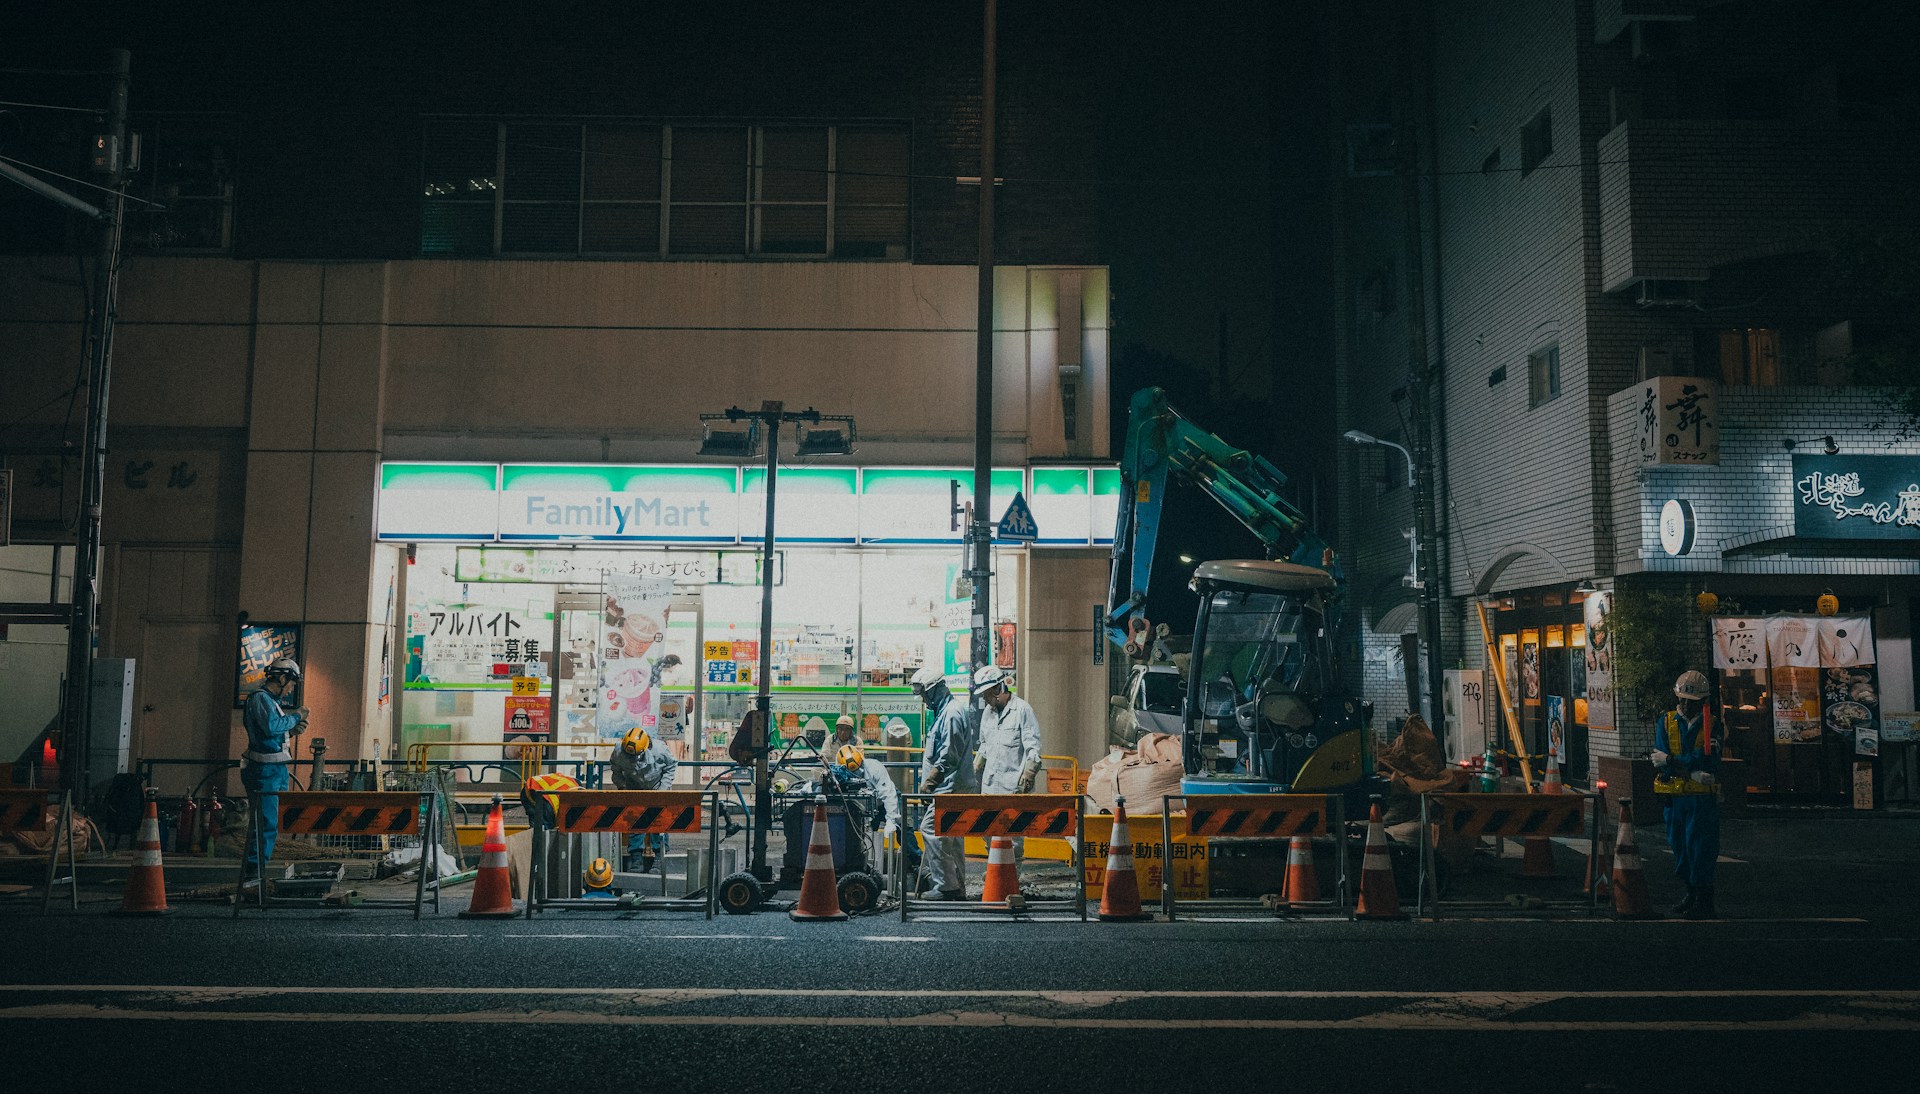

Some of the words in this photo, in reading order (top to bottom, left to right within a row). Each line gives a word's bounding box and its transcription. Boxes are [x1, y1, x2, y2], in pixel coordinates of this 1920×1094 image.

[1673, 452, 1707, 460] スナック
[526, 496, 710, 535] FamilyMart
[430, 611, 521, 637] アルバイト
[505, 639, 539, 663] 募集
[708, 646, 728, 655] 予告
[711, 663, 735, 671] たばこ
[516, 682, 536, 691] 予告
[1084, 842, 1204, 860] 重機動範囲内
[1085, 864, 1203, 888] 立禁止
